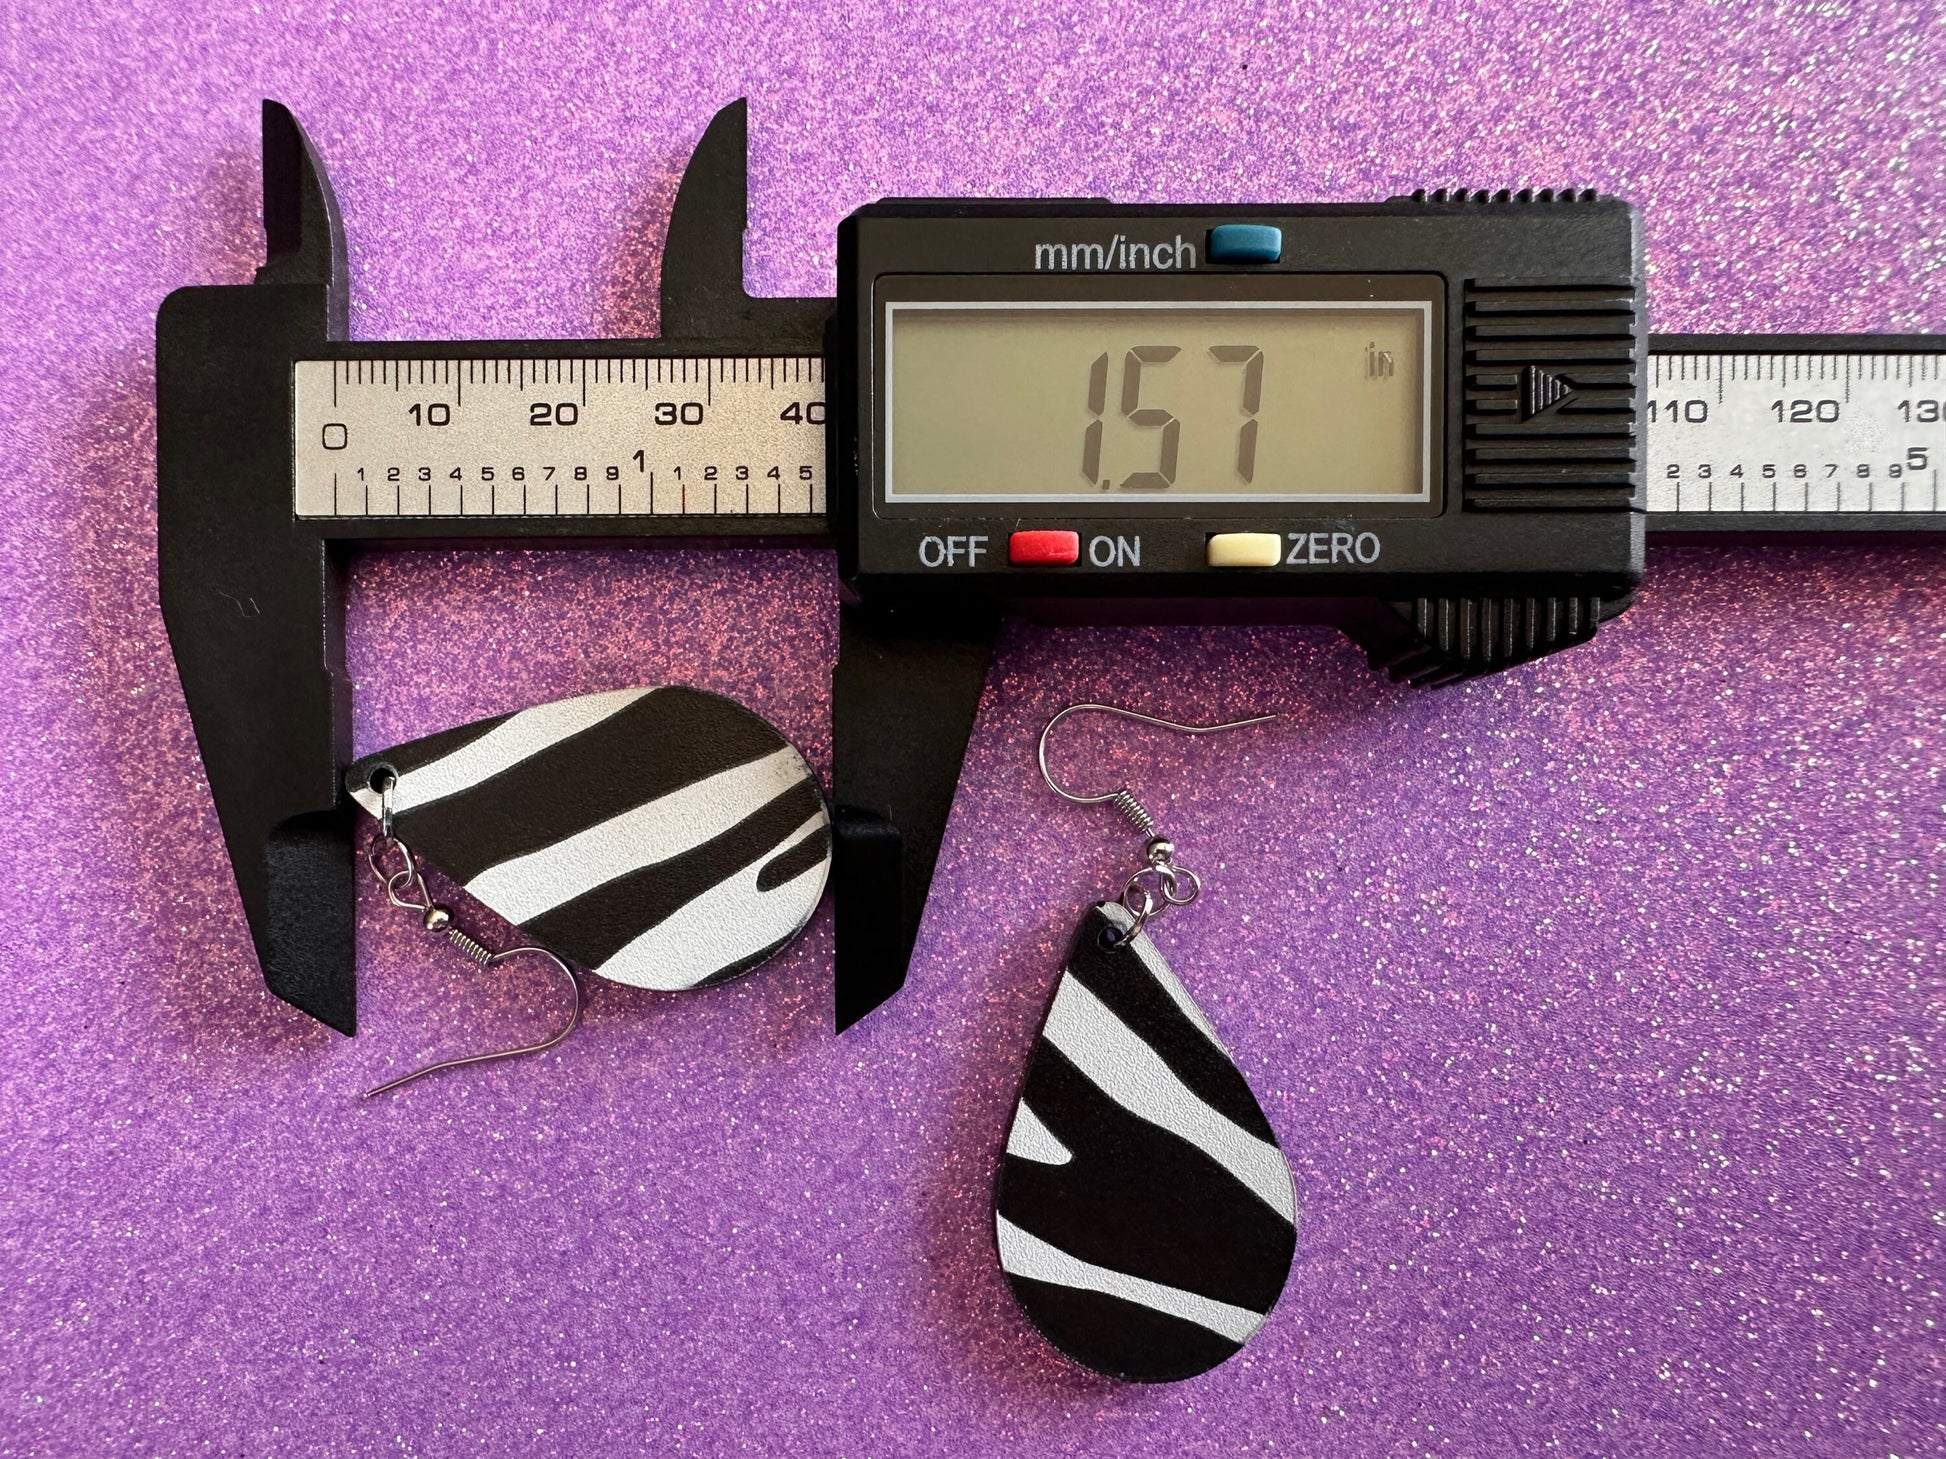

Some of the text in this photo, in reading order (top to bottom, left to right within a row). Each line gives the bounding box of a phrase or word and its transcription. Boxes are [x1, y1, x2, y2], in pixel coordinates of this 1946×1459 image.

[1034, 234, 1197, 271] mm/inch
[1364, 341, 1395, 378] in
[409, 401, 826, 426] 10 20 30 40
[1081, 344, 1265, 491] 1.57
[1647, 399, 1946, 423] 110 120 13
[322, 422, 348, 450] 0
[632, 449, 645, 473] 1
[1666, 464, 1902, 479] 2 3 4 5 6 7 8 9
[1906, 446, 1929, 471] 5
[387, 467, 400, 481] 2
[418, 467, 431, 481] 3
[449, 467, 462, 481] 4
[481, 467, 495, 481] 5
[512, 467, 525, 481] 6
[542, 467, 556, 481] 7
[574, 467, 588, 481] 8
[606, 467, 619, 481] 9
[704, 466, 717, 480] 2
[735, 466, 749, 480] 3
[767, 466, 780, 480] 4
[799, 466, 812, 480] 5
[918, 535, 988, 567] OFF
[1088, 535, 1141, 567] ON
[1286, 532, 1381, 565] ZERO
